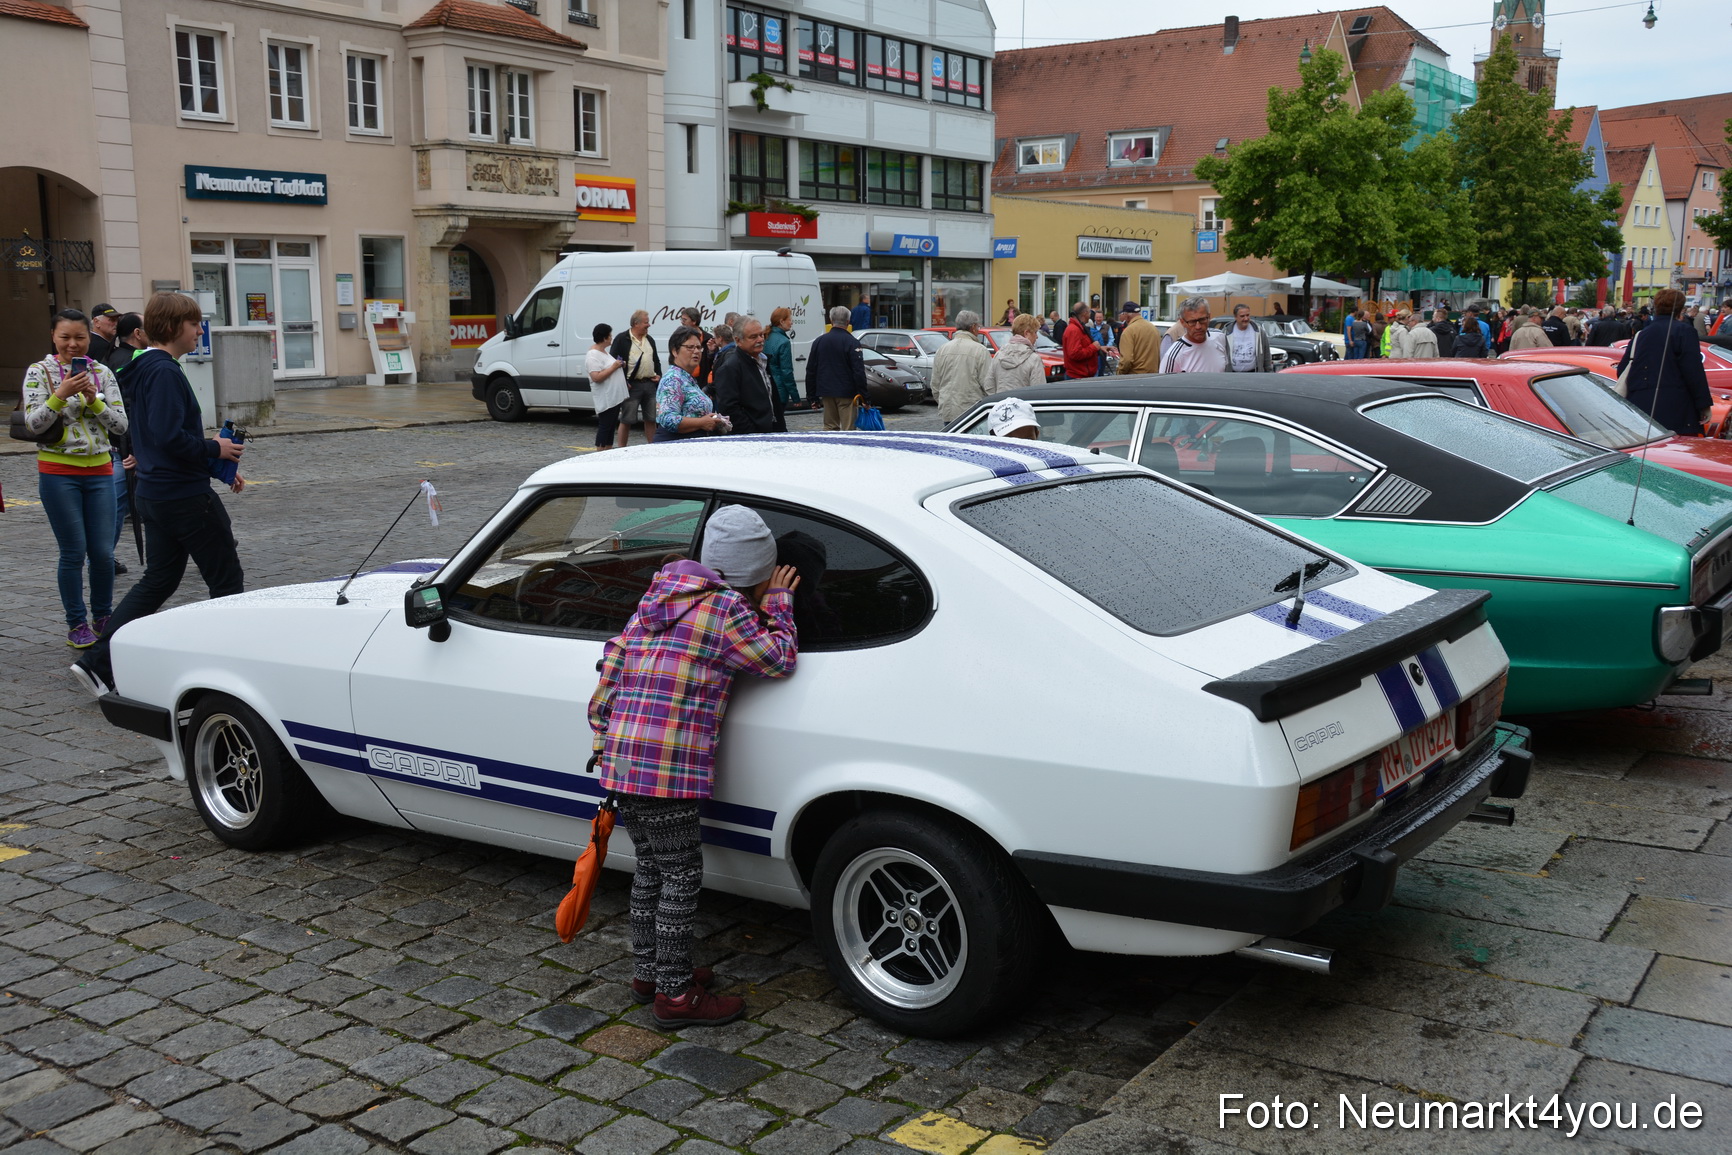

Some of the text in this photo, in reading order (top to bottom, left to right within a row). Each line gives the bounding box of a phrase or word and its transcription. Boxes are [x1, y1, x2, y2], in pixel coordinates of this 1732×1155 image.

[195, 172, 325, 197] Neumarkter Tagblatt
[576, 185, 631, 210] ORMA
[1080, 241, 1150, 255] GASTHAUS mittlere GANS
[651, 300, 717, 325] nasu
[449, 324, 488, 340] ORMA
[1294, 721, 1344, 752] CAPRI
[370, 747, 477, 787] CAPRI
[1381, 741, 1405, 785] RH
